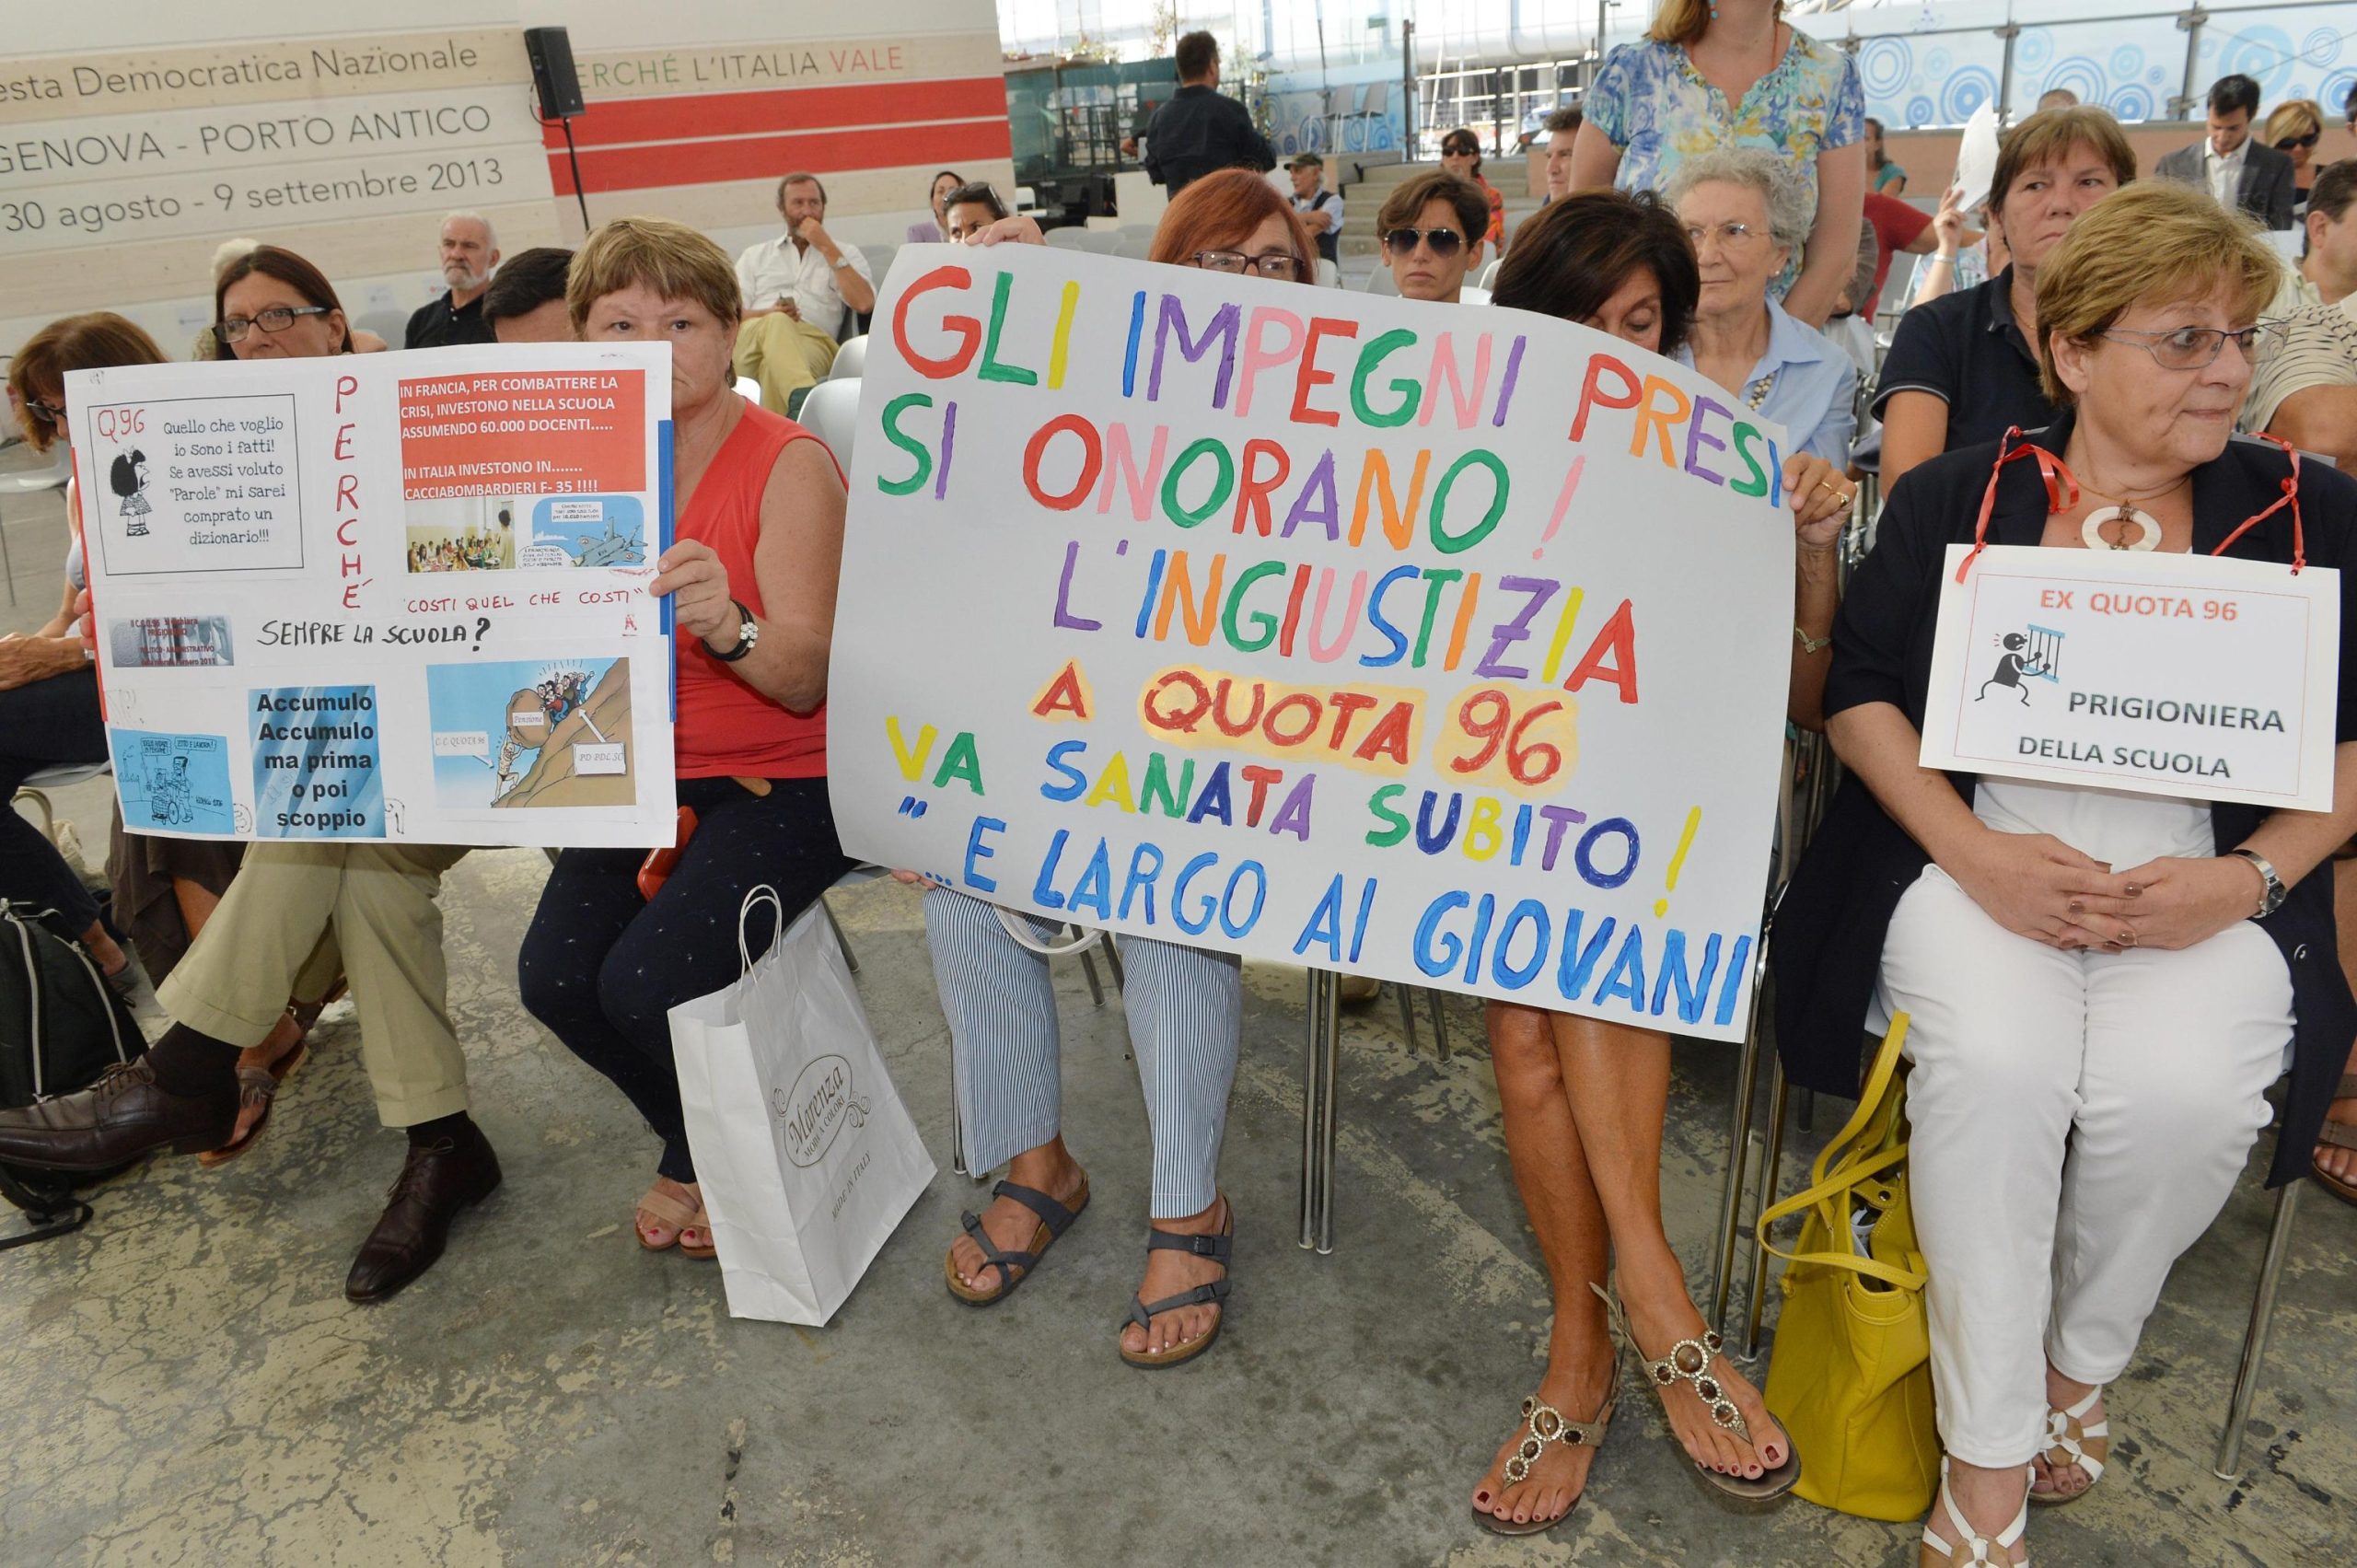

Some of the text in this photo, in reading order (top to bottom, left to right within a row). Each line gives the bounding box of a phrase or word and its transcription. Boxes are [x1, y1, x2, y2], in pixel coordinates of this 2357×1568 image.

[74, 57, 302, 98] Democratica
[313, 40, 478, 78] Nazionale
[575, 46, 903, 88] ERCHÉ L'ITALIA VALE
[0, 132, 165, 173] GENOVA
[201, 116, 335, 156] PORTO
[348, 104, 491, 144] ANTICO
[2, 201, 45, 231] 30
[59, 192, 180, 232] agosto
[215, 183, 234, 213] 9
[247, 169, 418, 209] settembre
[427, 157, 504, 191] 2013
[400, 376, 618, 399] IN FRANCIA, PER COMBATTERE LA
[892, 265, 1783, 508] GLI IMPEGNI PRESI
[401, 397, 615, 420] CRISI, INVESTONO NELLA SCUOLA
[98, 409, 145, 443] Q96
[163, 416, 284, 435] Quello che voglio
[401, 422, 478, 440] ASSUMENDO
[480, 420, 525, 435] 60.000
[174, 439, 274, 457] io sono i fatti!
[169, 461, 284, 479] Se avessi voluto
[404, 467, 416, 480] IN
[420, 465, 457, 479] ITALIA
[459, 461, 533, 477] INVESTONO
[877, 393, 958, 500] SI
[1022, 413, 1510, 554] ONORANO
[169, 483, 286, 501] "Parole" mi sarei
[404, 481, 537, 501] CACCIABOMBARDIERI
[556, 480, 574, 493] 35
[183, 509, 273, 526] comprato un
[190, 529, 269, 545] dizionario!!!
[466, 596, 515, 610] QUEL
[529, 591, 561, 606] CHE
[2040, 588, 2238, 621] EX QUOTA 96
[257, 620, 346, 646] SEMPRE
[354, 624, 373, 644] LA
[1053, 539, 1639, 705] L'INGIUSTIZIA
[257, 692, 373, 713] Accumulo
[2068, 691, 2286, 734] PRIGIONIERA
[258, 721, 374, 741] Accumulo
[1033, 661, 1563, 786] A QUOTA 96
[264, 750, 372, 773] ma prima
[2018, 736, 2231, 779] DELLA SCUOLA
[292, 779, 348, 802] o poi
[885, 715, 985, 796] VA
[1040, 740, 1318, 842] SANATA
[1364, 784, 1641, 890] SUBITO
[277, 806, 366, 831] scoppio
[1033, 829, 1267, 940] LARGO
[1293, 872, 1378, 964] AI
[1412, 889, 1752, 1026] GIOVANI
[789, 1065, 844, 1155] Marenza
[824, 1095, 845, 1128] COLORI
[853, 1150, 871, 1181] ITALY
